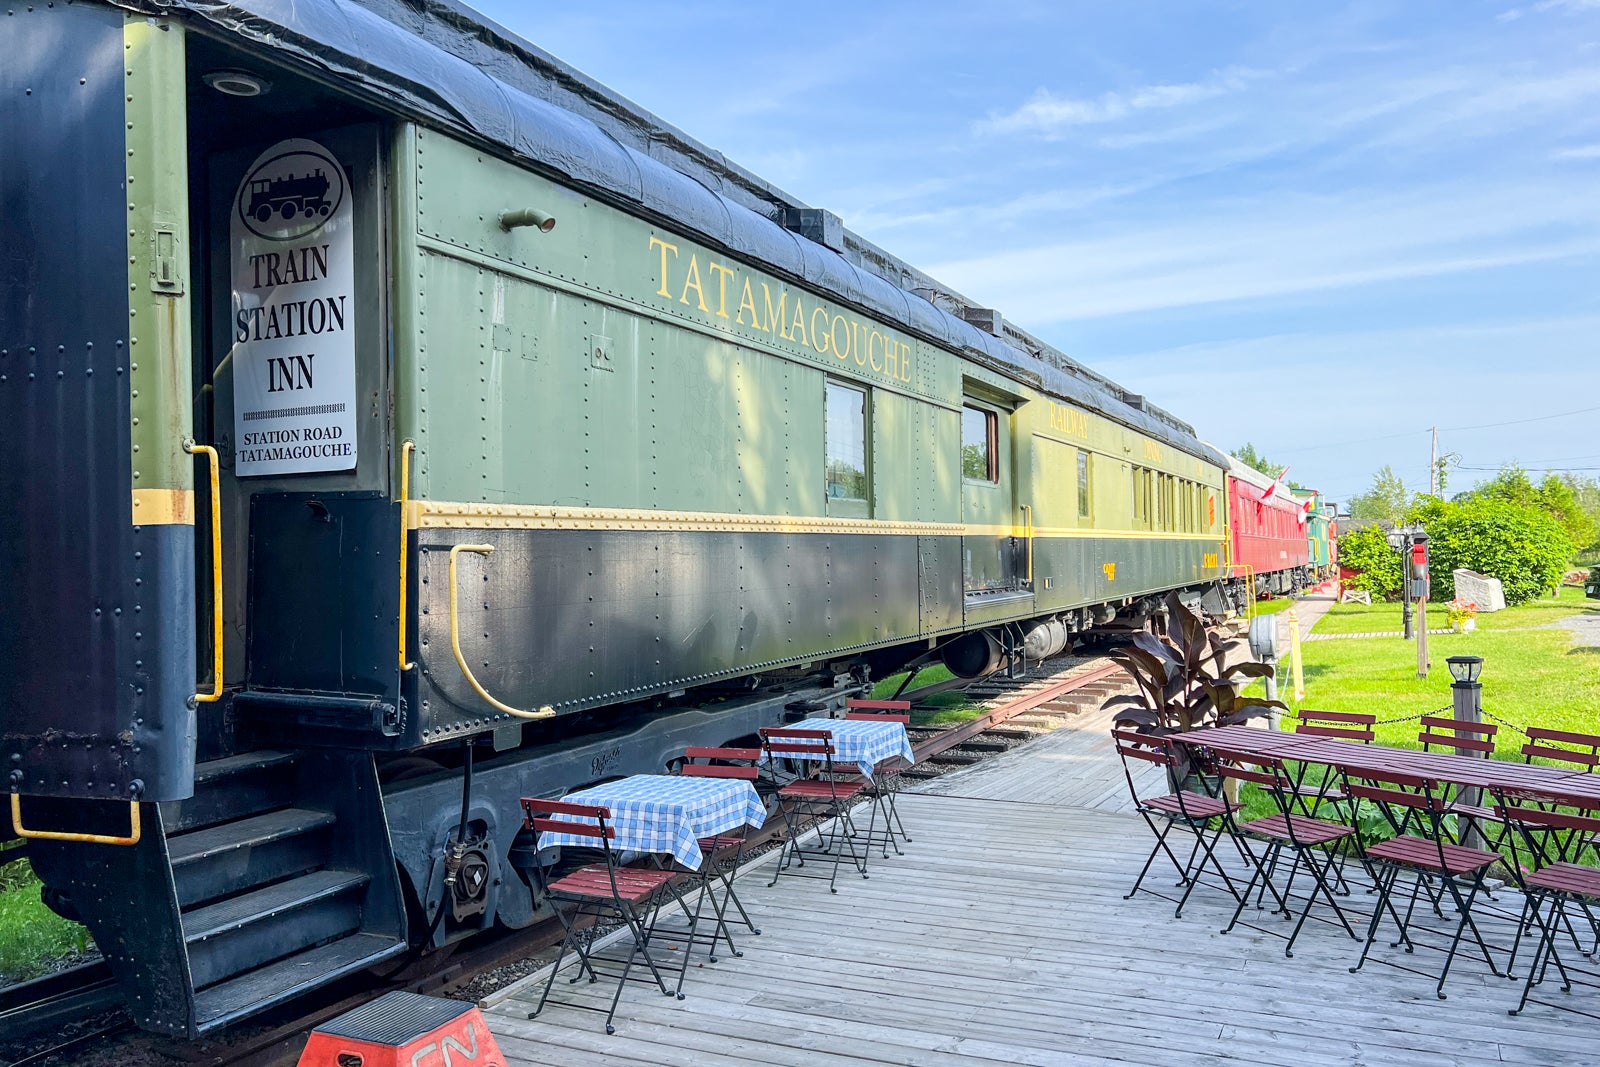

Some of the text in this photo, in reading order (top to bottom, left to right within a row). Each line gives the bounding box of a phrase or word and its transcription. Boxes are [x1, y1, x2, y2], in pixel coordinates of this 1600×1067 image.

[249, 244, 331, 289] TRAIN
[236, 295, 347, 343] STATION
[649, 236, 1089, 439] TATAMAGOUCHE RAILWAY
[267, 353, 315, 393] INN
[239, 443, 352, 463] TATAMAGOUCHE
[243, 426, 343, 446] STATION ROAD
